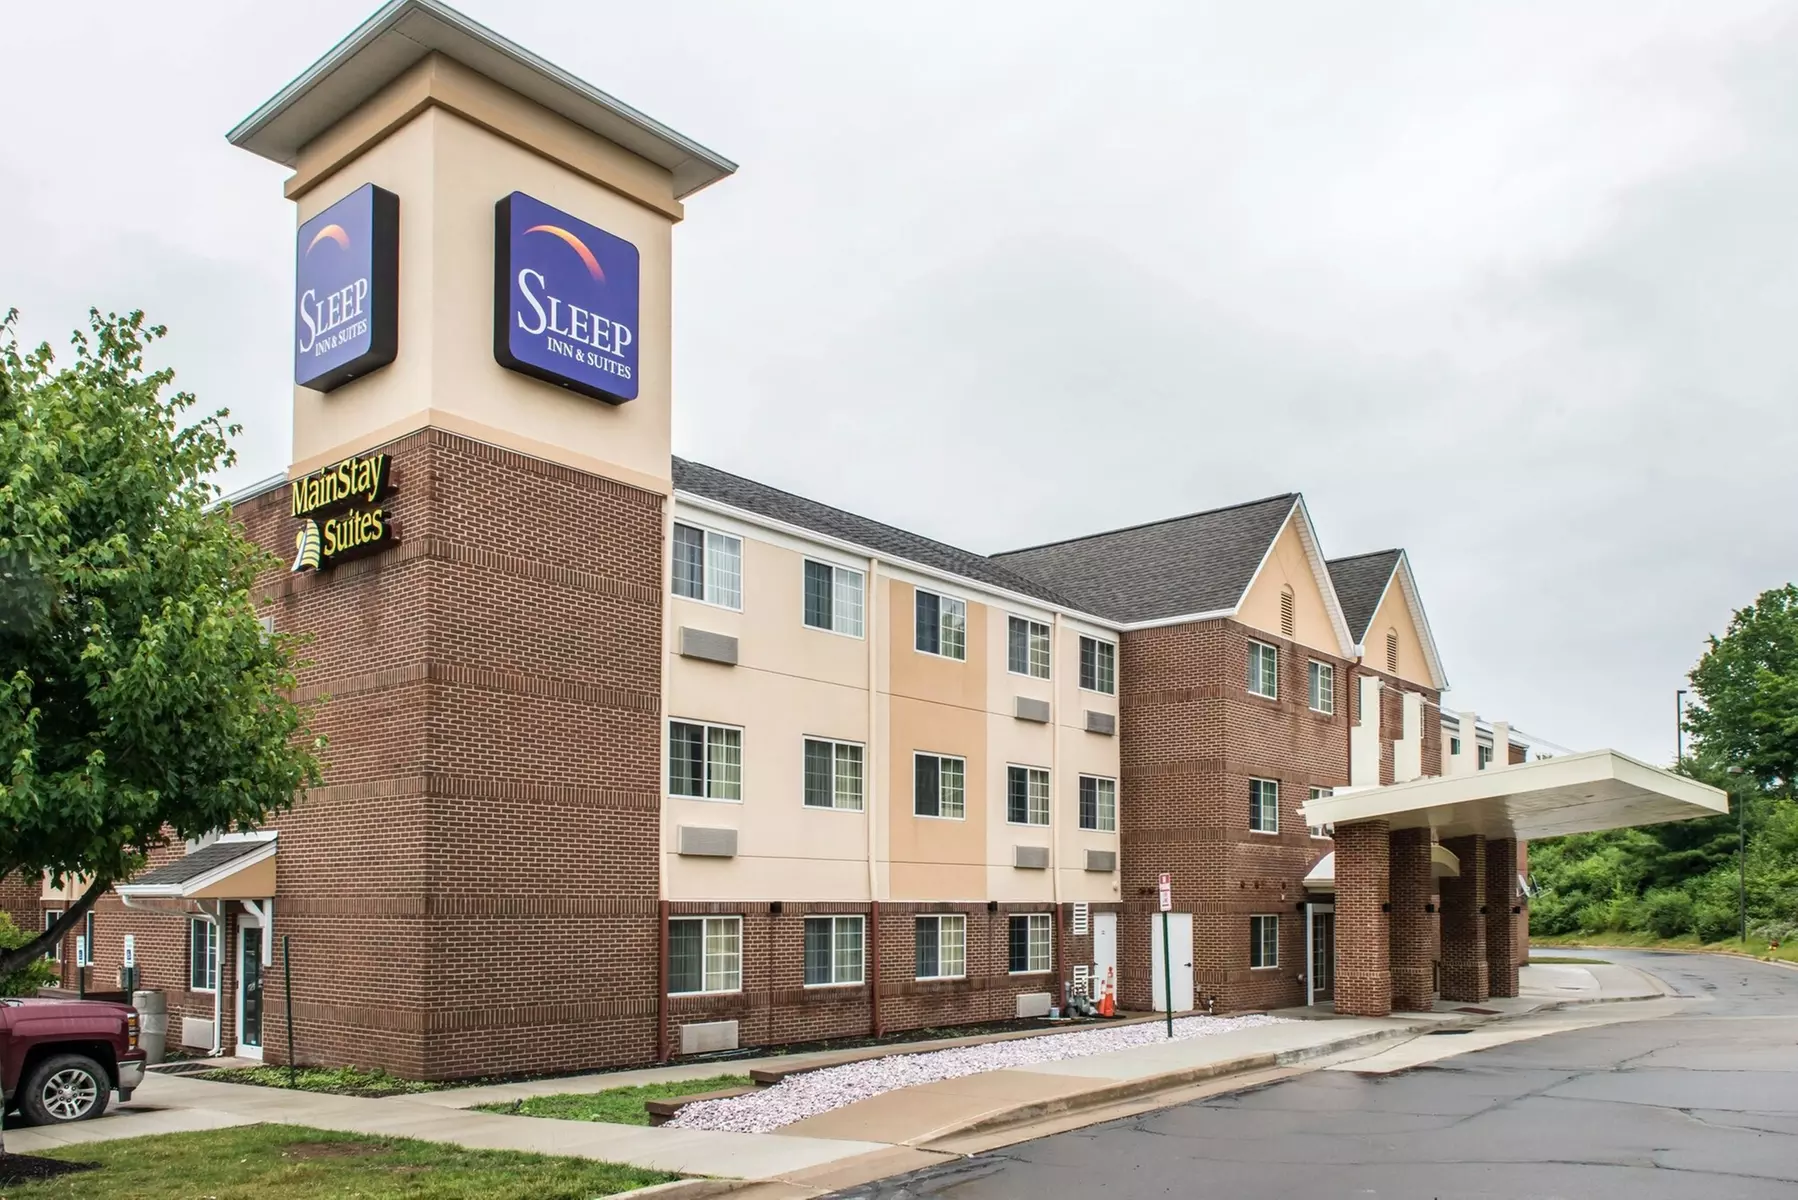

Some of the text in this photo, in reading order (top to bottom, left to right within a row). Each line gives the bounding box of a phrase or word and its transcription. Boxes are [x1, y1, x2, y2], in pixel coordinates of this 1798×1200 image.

[300, 278, 368, 354] SLEEP
[315, 318, 368, 357] INN & SUITES
[518, 268, 632, 358] SLEEP
[547, 336, 632, 380] INN & SUITES
[291, 453, 384, 517] MainStay
[323, 508, 383, 556] Suites
